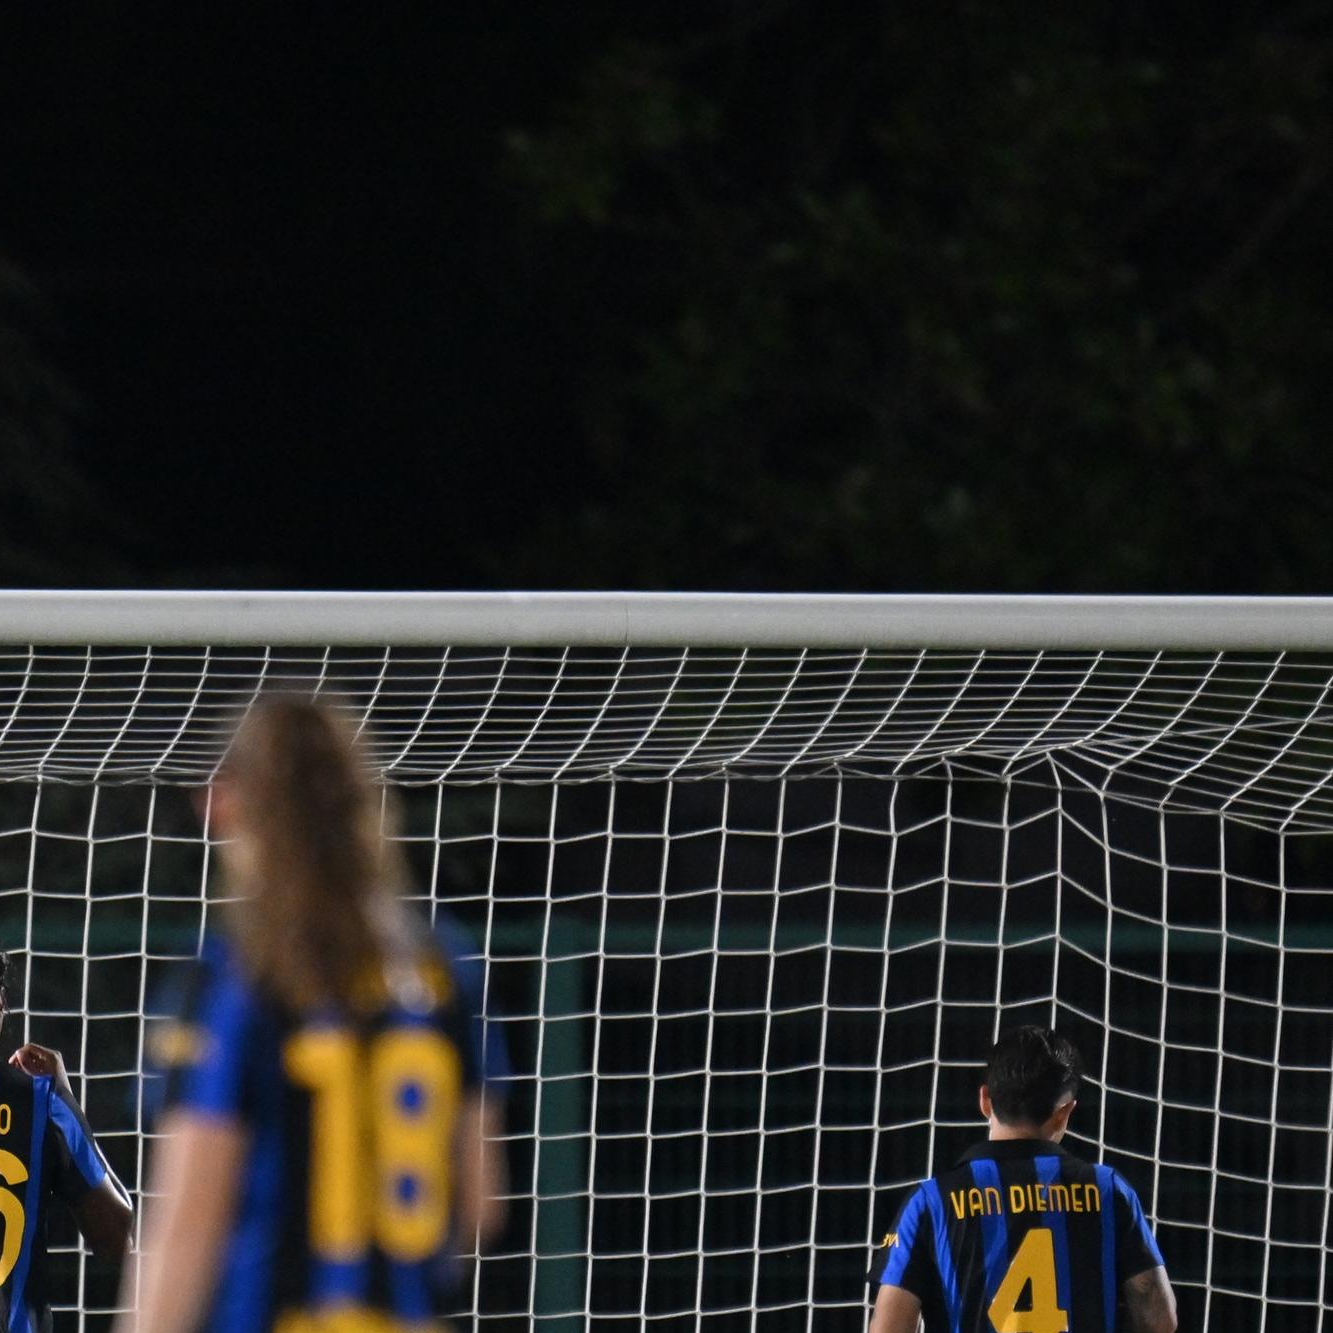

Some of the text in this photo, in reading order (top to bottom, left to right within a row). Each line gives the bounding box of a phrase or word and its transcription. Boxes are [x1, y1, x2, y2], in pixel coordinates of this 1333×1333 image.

[279, 1026, 462, 1263] 18
[951, 1183, 1101, 1220] VAN DIEMEN
